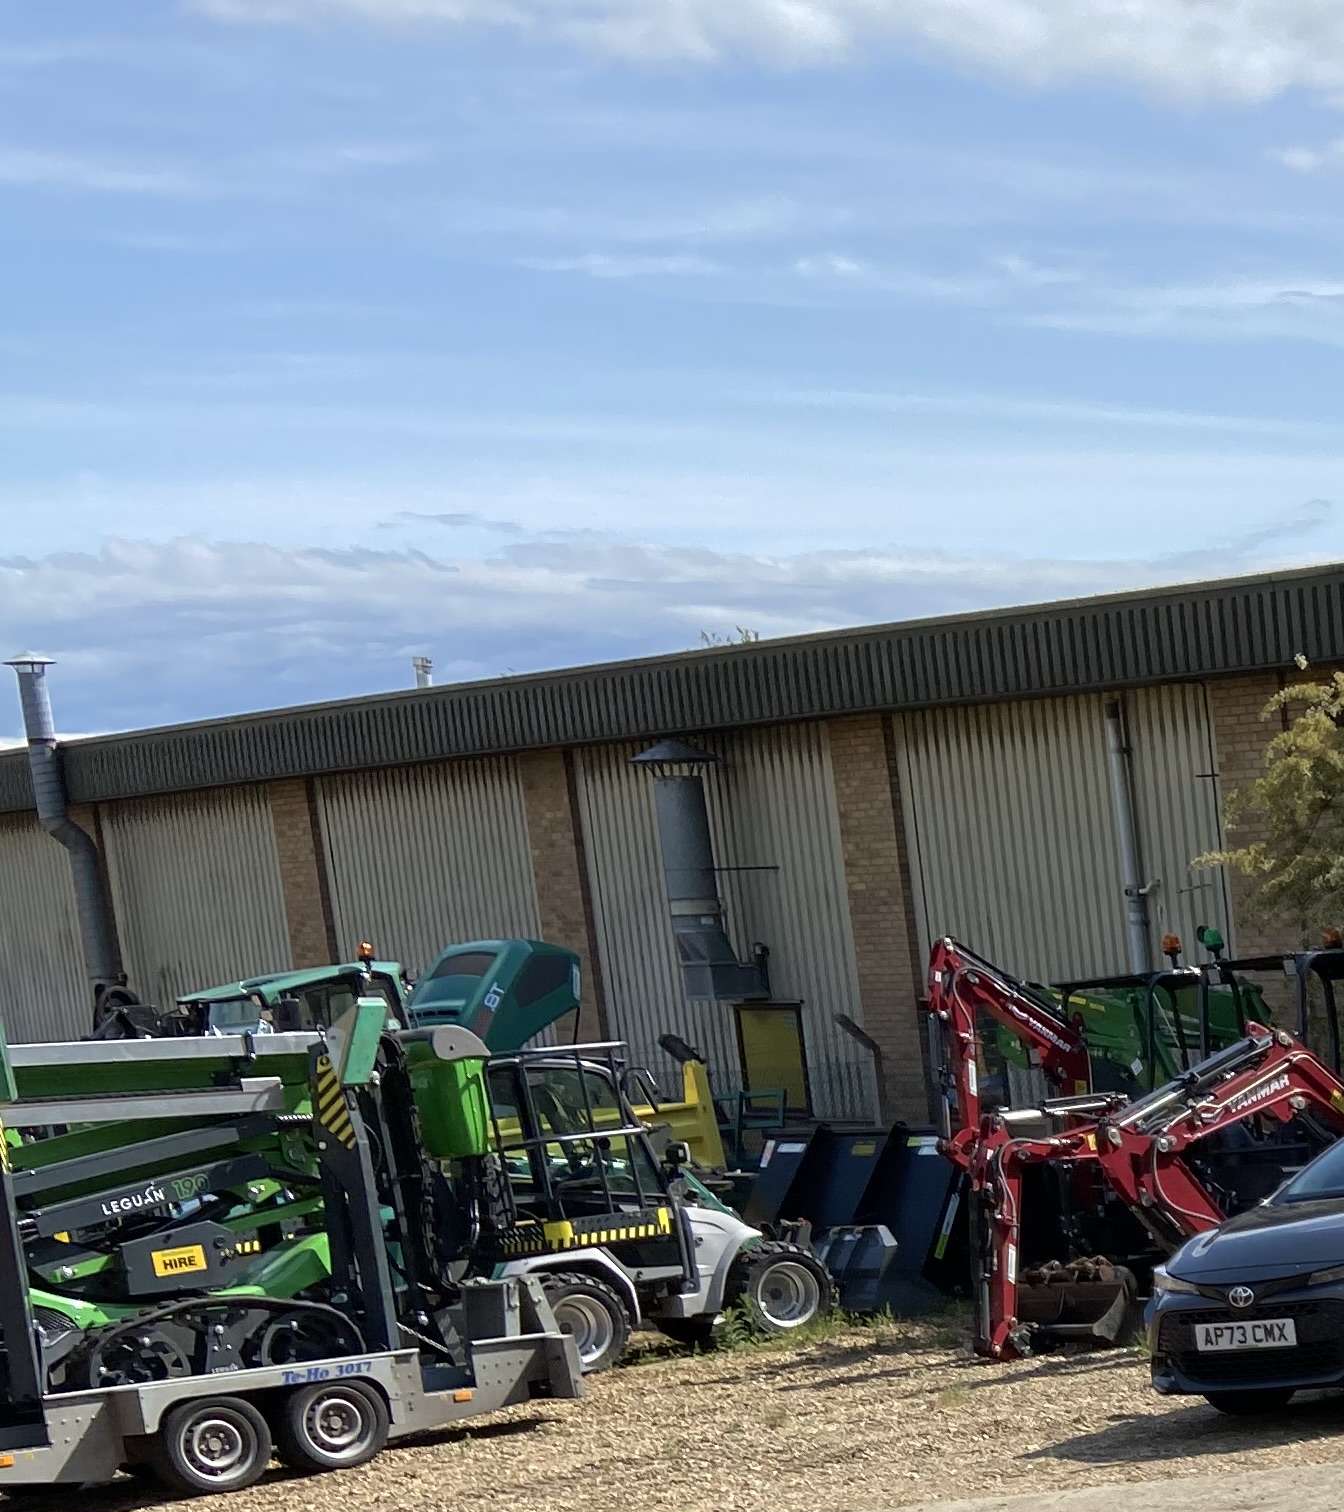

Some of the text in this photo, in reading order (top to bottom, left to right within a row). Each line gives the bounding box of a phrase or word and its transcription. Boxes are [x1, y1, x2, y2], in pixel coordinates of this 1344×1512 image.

[1229, 1074, 1290, 1113] YANMAR
[171, 1173, 210, 1200] 190
[162, 1255, 198, 1271] HIRE
[1204, 1322, 1288, 1346] AP73 CMX
[335, 1361, 372, 1377] 3017
